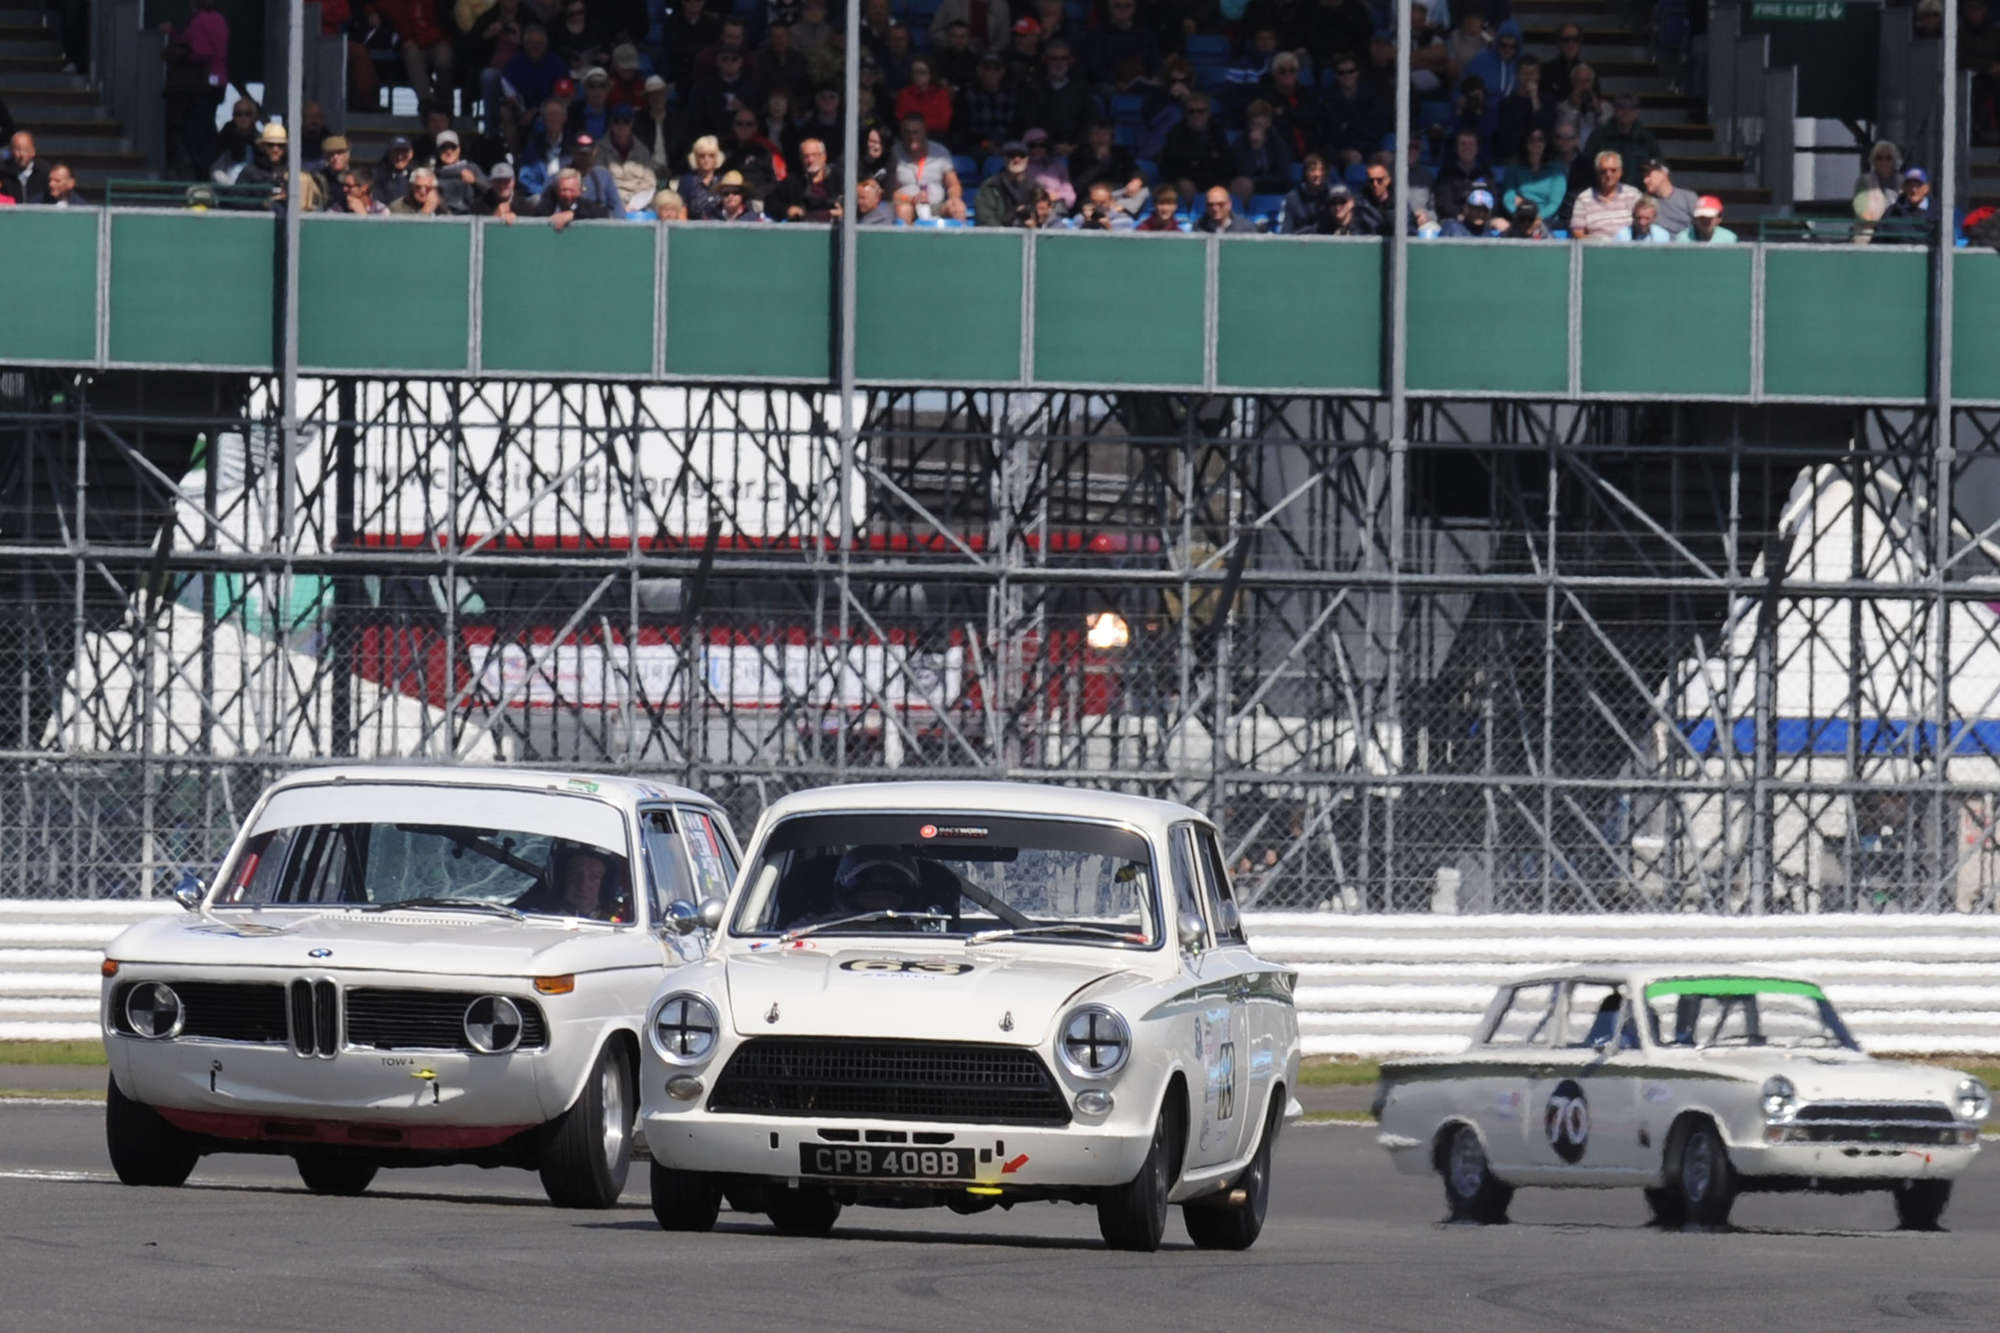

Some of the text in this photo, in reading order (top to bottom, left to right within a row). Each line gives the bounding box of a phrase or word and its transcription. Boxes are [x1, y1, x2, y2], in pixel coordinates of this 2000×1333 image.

[1754, 4, 1813, 16] FIRE EXIT
[851, 960, 960, 975] 63
[381, 1057, 407, 1066] TOW
[1551, 1096, 1587, 1145] 70
[815, 1148, 959, 1175] CPB 408B
